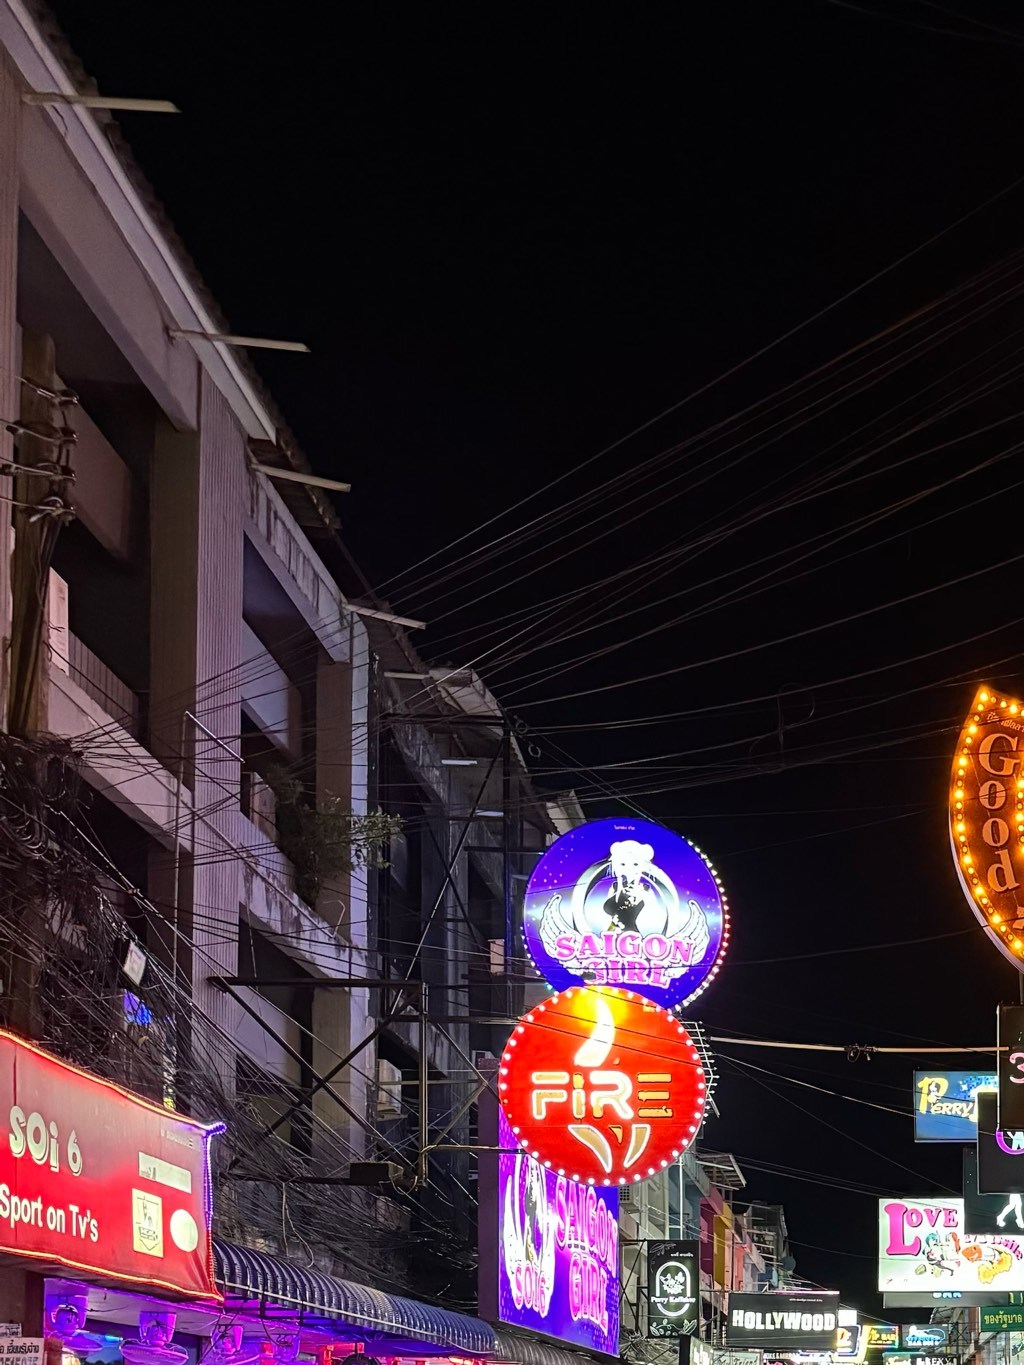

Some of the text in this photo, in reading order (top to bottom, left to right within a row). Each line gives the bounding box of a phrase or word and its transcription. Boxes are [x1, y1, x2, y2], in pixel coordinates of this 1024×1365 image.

[978, 732, 1020, 893] Good
[555, 931, 696, 966] SAIGON
[585, 962, 671, 989] GIRL
[67, 1130, 82, 1176] 6
[0, 1183, 43, 1228] Sport
[46, 1206, 66, 1233] on
[69, 1204, 99, 1243] Tv's
[555, 1176, 618, 1279] SAIGON
[884, 1203, 959, 1256] LOVE
[569, 1252, 609, 1337] GIRL
[732, 1309, 836, 1331] HOLLYWOOD
